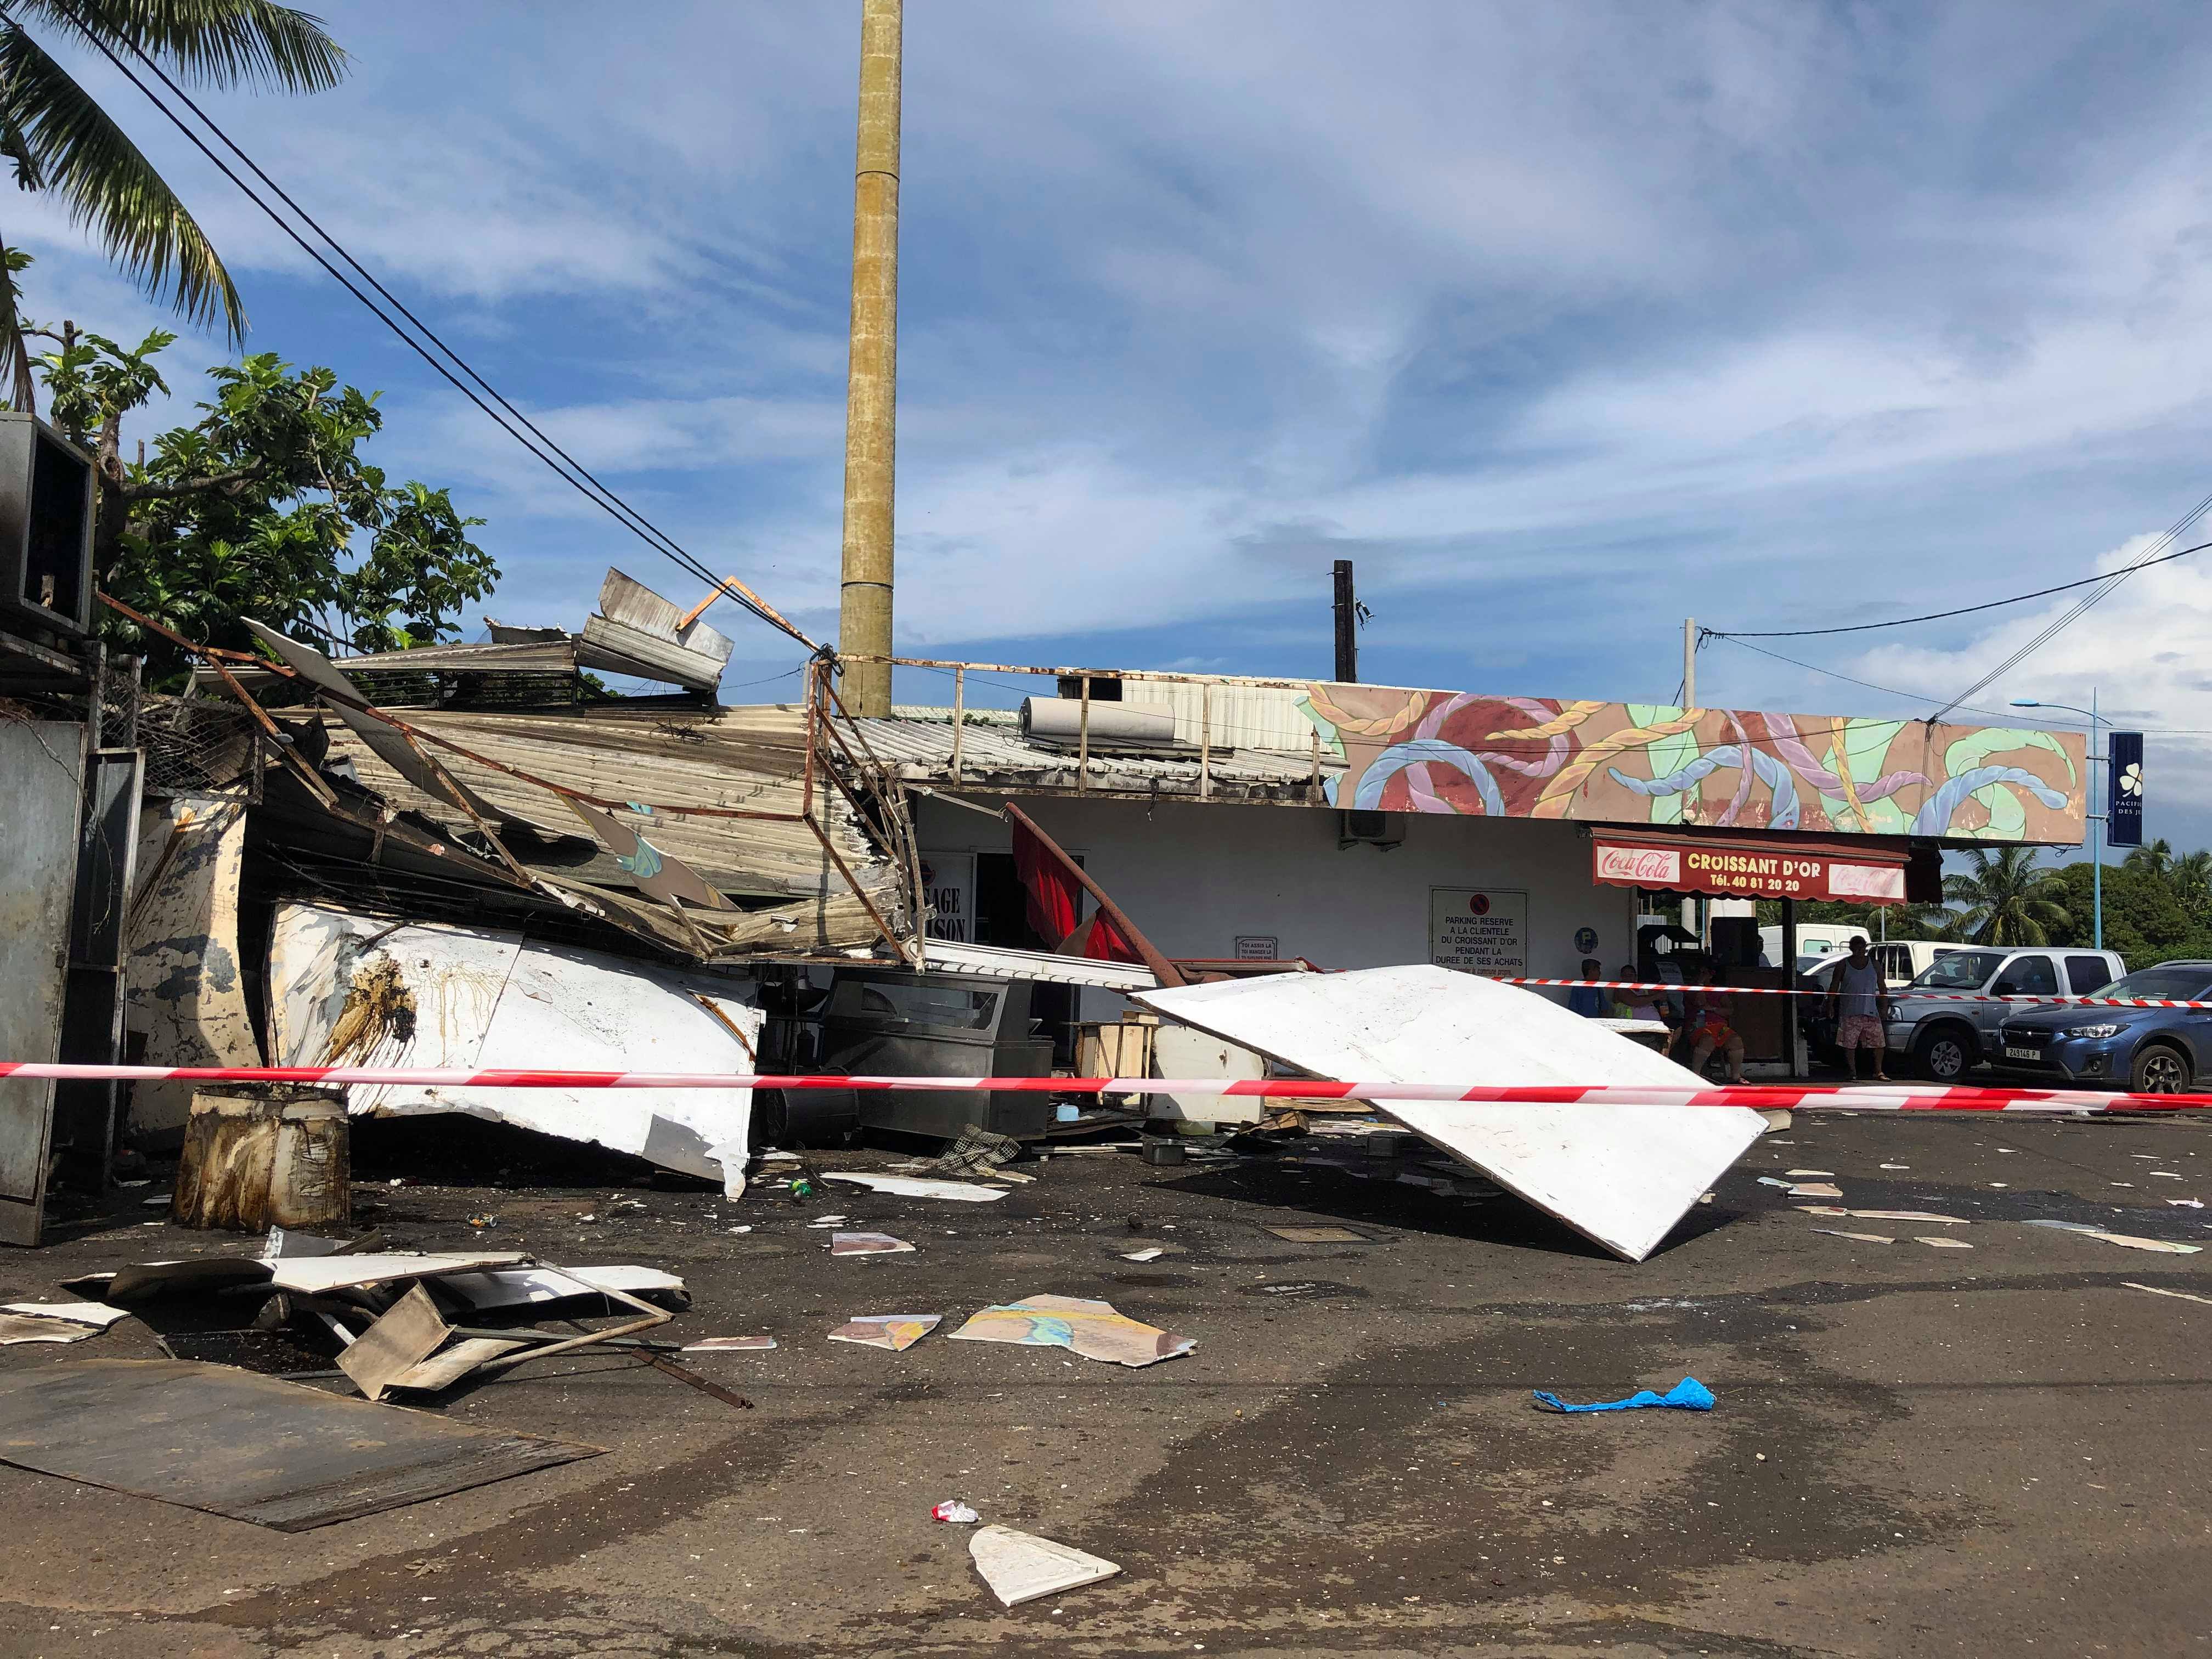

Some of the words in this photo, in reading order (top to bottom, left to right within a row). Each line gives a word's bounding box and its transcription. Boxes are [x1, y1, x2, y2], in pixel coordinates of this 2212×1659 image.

[1602, 850, 1673, 878] Coca-Cola
[1688, 853, 1778, 874] CROISSANT
[1783, 860, 1820, 877] D'OR
[1711, 874, 1730, 887] Tél.
[1732, 876, 1746, 888] 40
[1751, 877, 1763, 889] 81
[1768, 878, 1782, 890] 20
[1785, 880, 1799, 891] 20
[1480, 918, 1514, 926] RESERVE
[1470, 927, 1509, 935] CLIENTELE
[1455, 936, 1497, 945] CROISSANT
[1494, 958, 1523, 966] ACHATS
